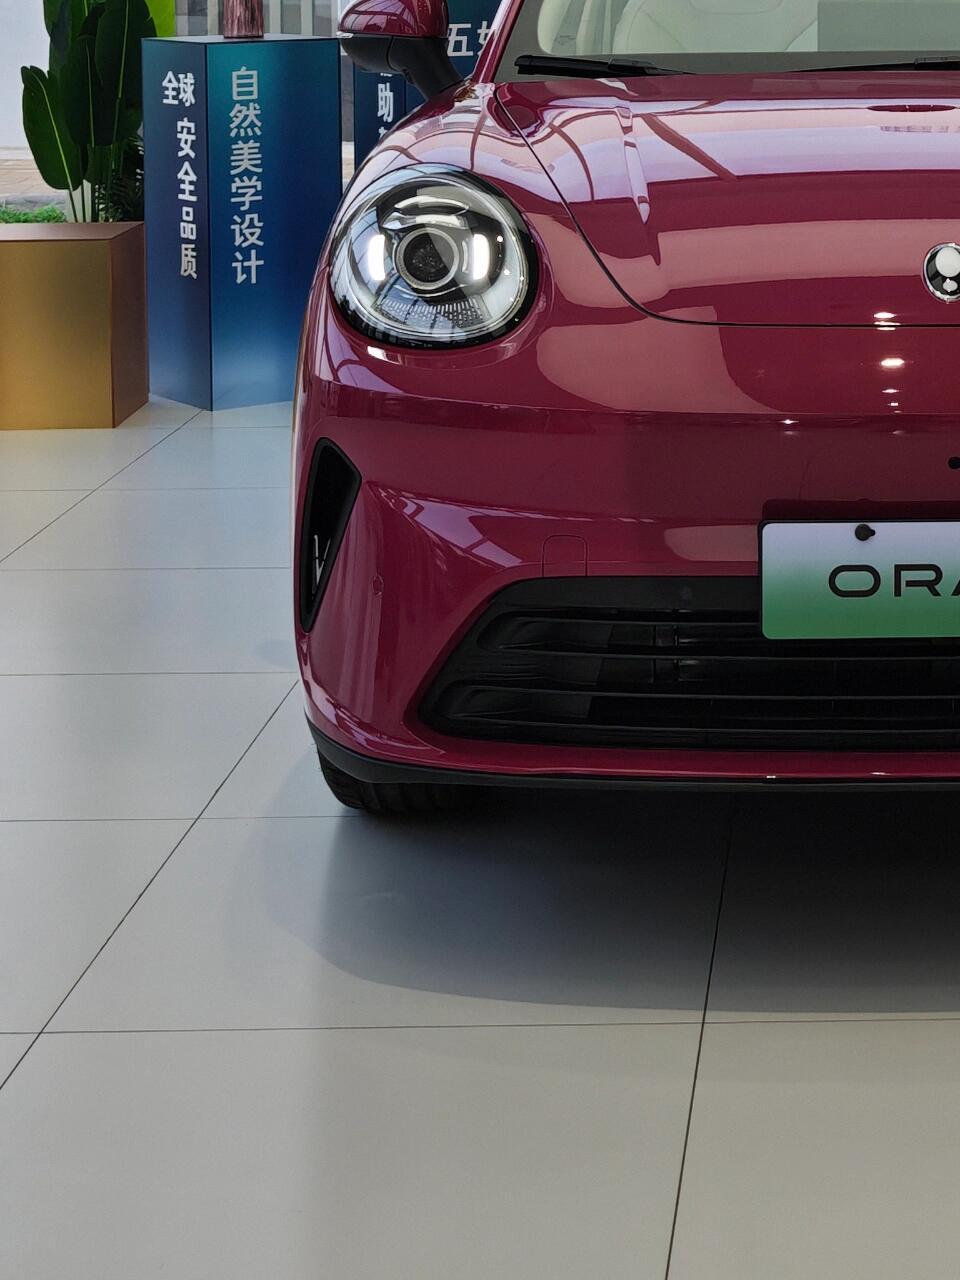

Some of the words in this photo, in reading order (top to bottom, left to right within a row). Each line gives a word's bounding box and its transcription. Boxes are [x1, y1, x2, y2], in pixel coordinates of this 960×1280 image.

[162, 70, 195, 107] 全球
[176, 117, 197, 280] 安全品质
[229, 66, 264, 285] 自然美学设计
